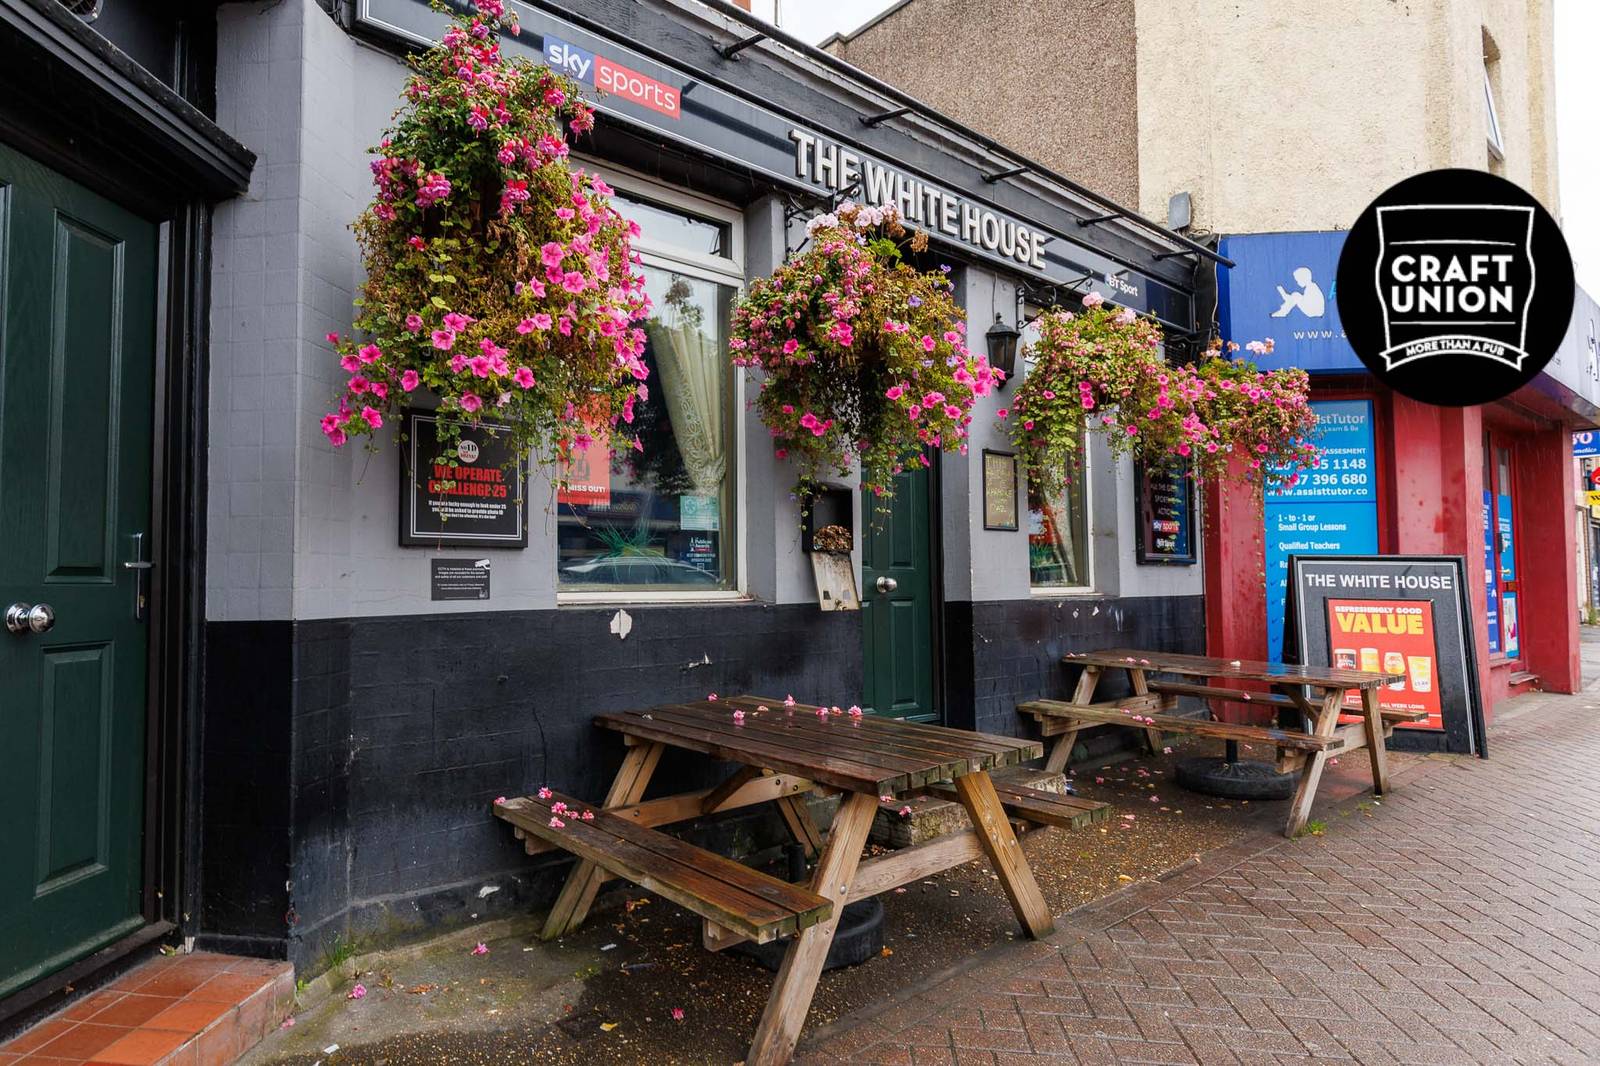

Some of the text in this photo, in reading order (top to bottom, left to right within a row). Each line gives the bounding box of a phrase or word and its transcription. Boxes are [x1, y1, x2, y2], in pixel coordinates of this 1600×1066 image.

[549, 44, 676, 111] sky sports
[789, 129, 1047, 269] THE WHITE HOUSE
[1120, 280, 1138, 296] Sport
[1333, 459, 1367, 470] 1148
[434, 464, 503, 482] WE OPERATE
[1312, 473, 1338, 485] 396
[1341, 473, 1367, 485] 680
[493, 484, 507, 498] 25
[568, 484, 587, 492] MISS
[588, 485, 606, 493] OUT!
[1163, 522, 1178, 532] spos
[1278, 523, 1347, 533] Small Group Lessons
[1279, 542, 1341, 551] Qualified Teachers
[1305, 574, 1452, 590] THE WHITE HOUSE
[1335, 606, 1394, 614] REFRESHINGLY
[1335, 612, 1424, 635] VALUE
